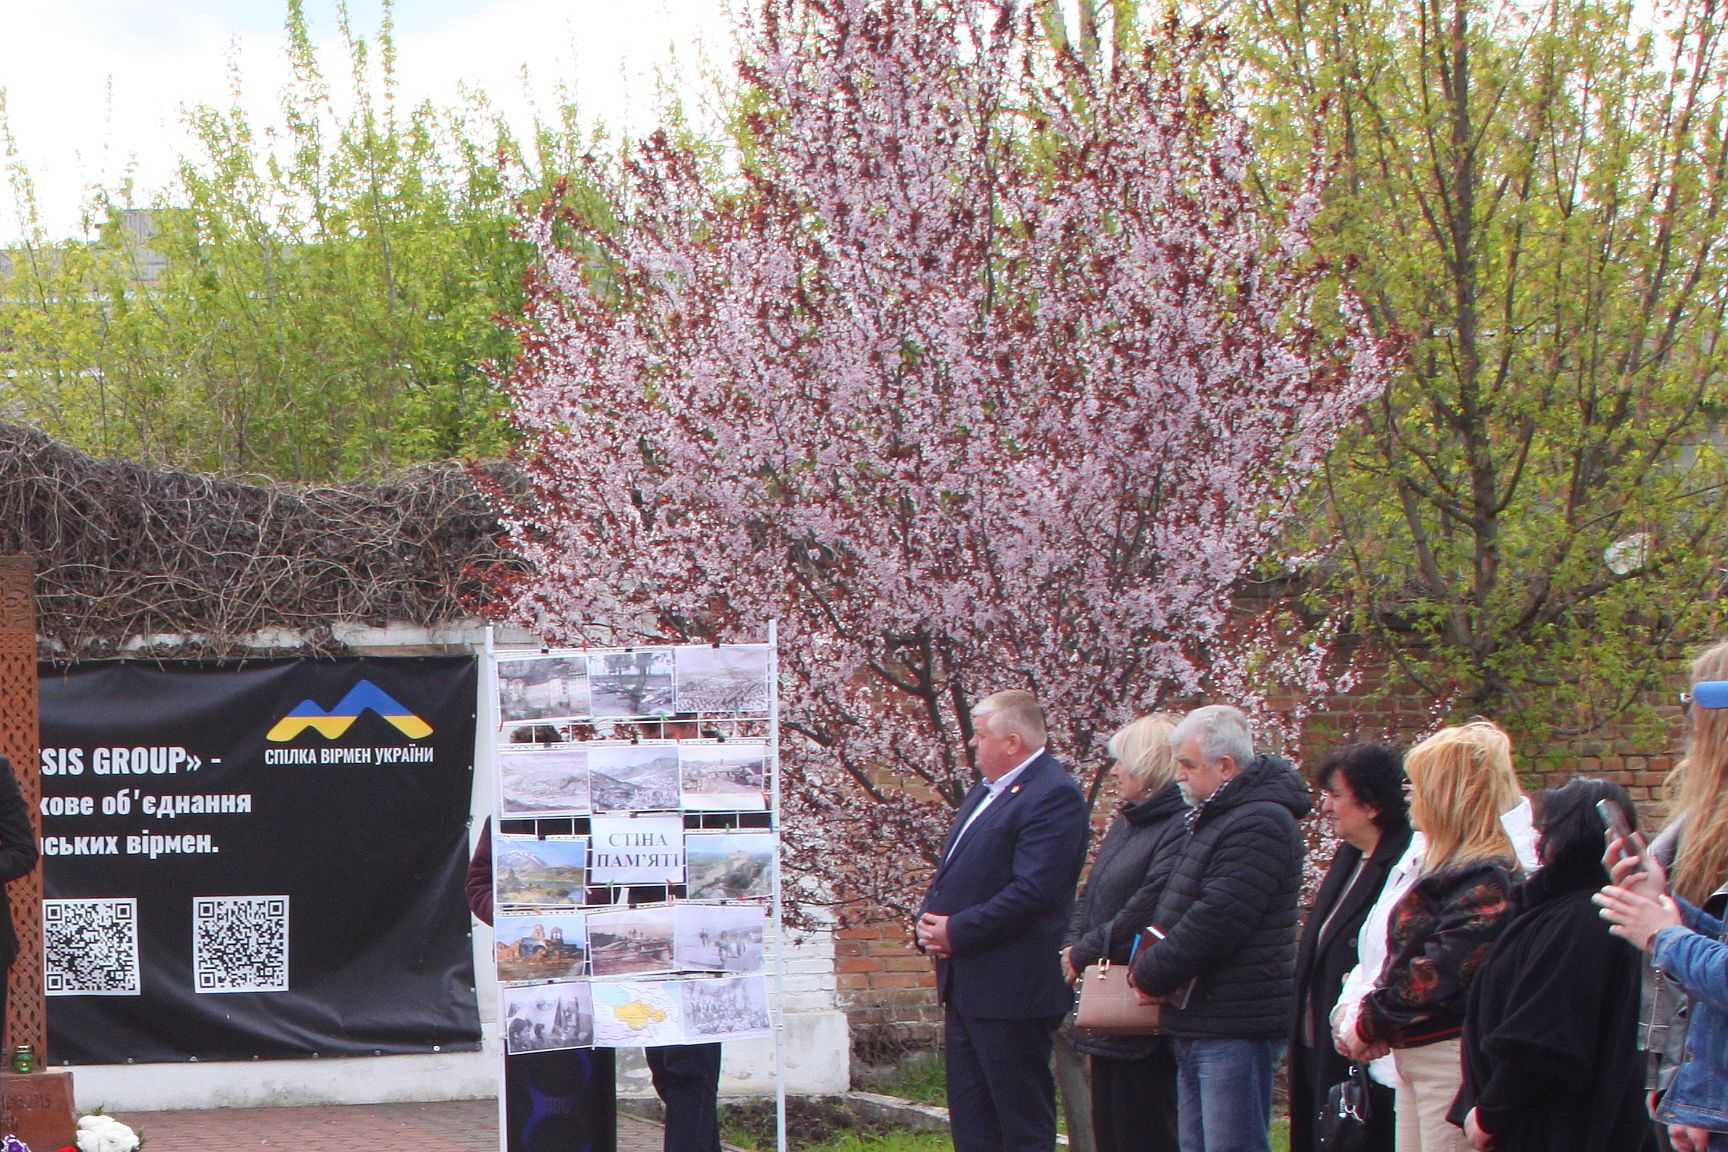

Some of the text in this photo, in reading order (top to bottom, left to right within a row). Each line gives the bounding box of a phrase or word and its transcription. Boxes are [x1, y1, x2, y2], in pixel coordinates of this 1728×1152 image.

[39, 747, 85, 776] SIS
[92, 746, 203, 775] GROUP»
[264, 743, 434, 765] СПІЛКА ВІРМЕН УКРАЇНИ
[40, 829, 219, 859] ських вірмен.
[607, 832, 669, 848] СТІНА
